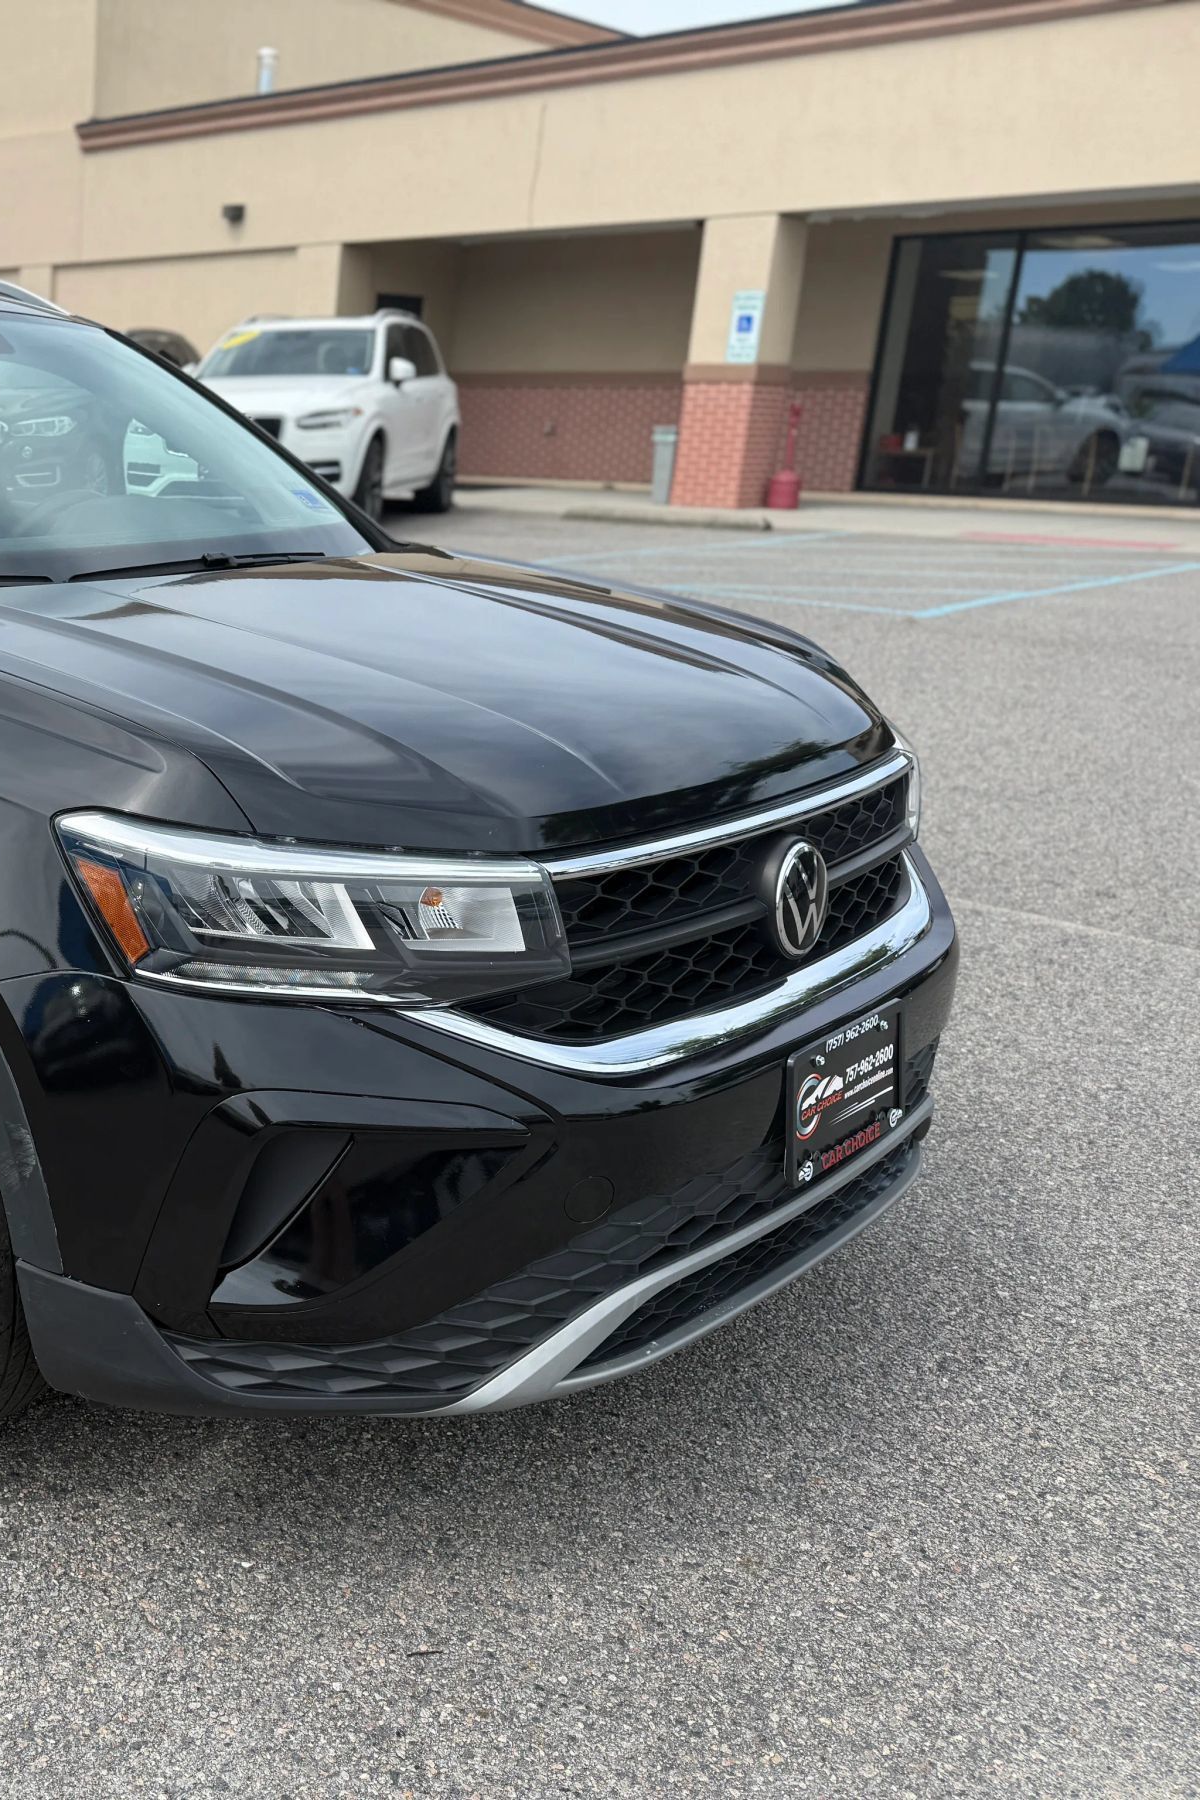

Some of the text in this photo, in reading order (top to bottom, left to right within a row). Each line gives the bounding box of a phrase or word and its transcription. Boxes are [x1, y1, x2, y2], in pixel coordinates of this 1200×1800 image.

[825, 1014, 879, 1054] (757) 962-2600
[845, 1044, 894, 1085] 757-962-2600
[801, 1091, 843, 1121] CAR CHOICE
[821, 1122, 881, 1170] CAR CHOICE
